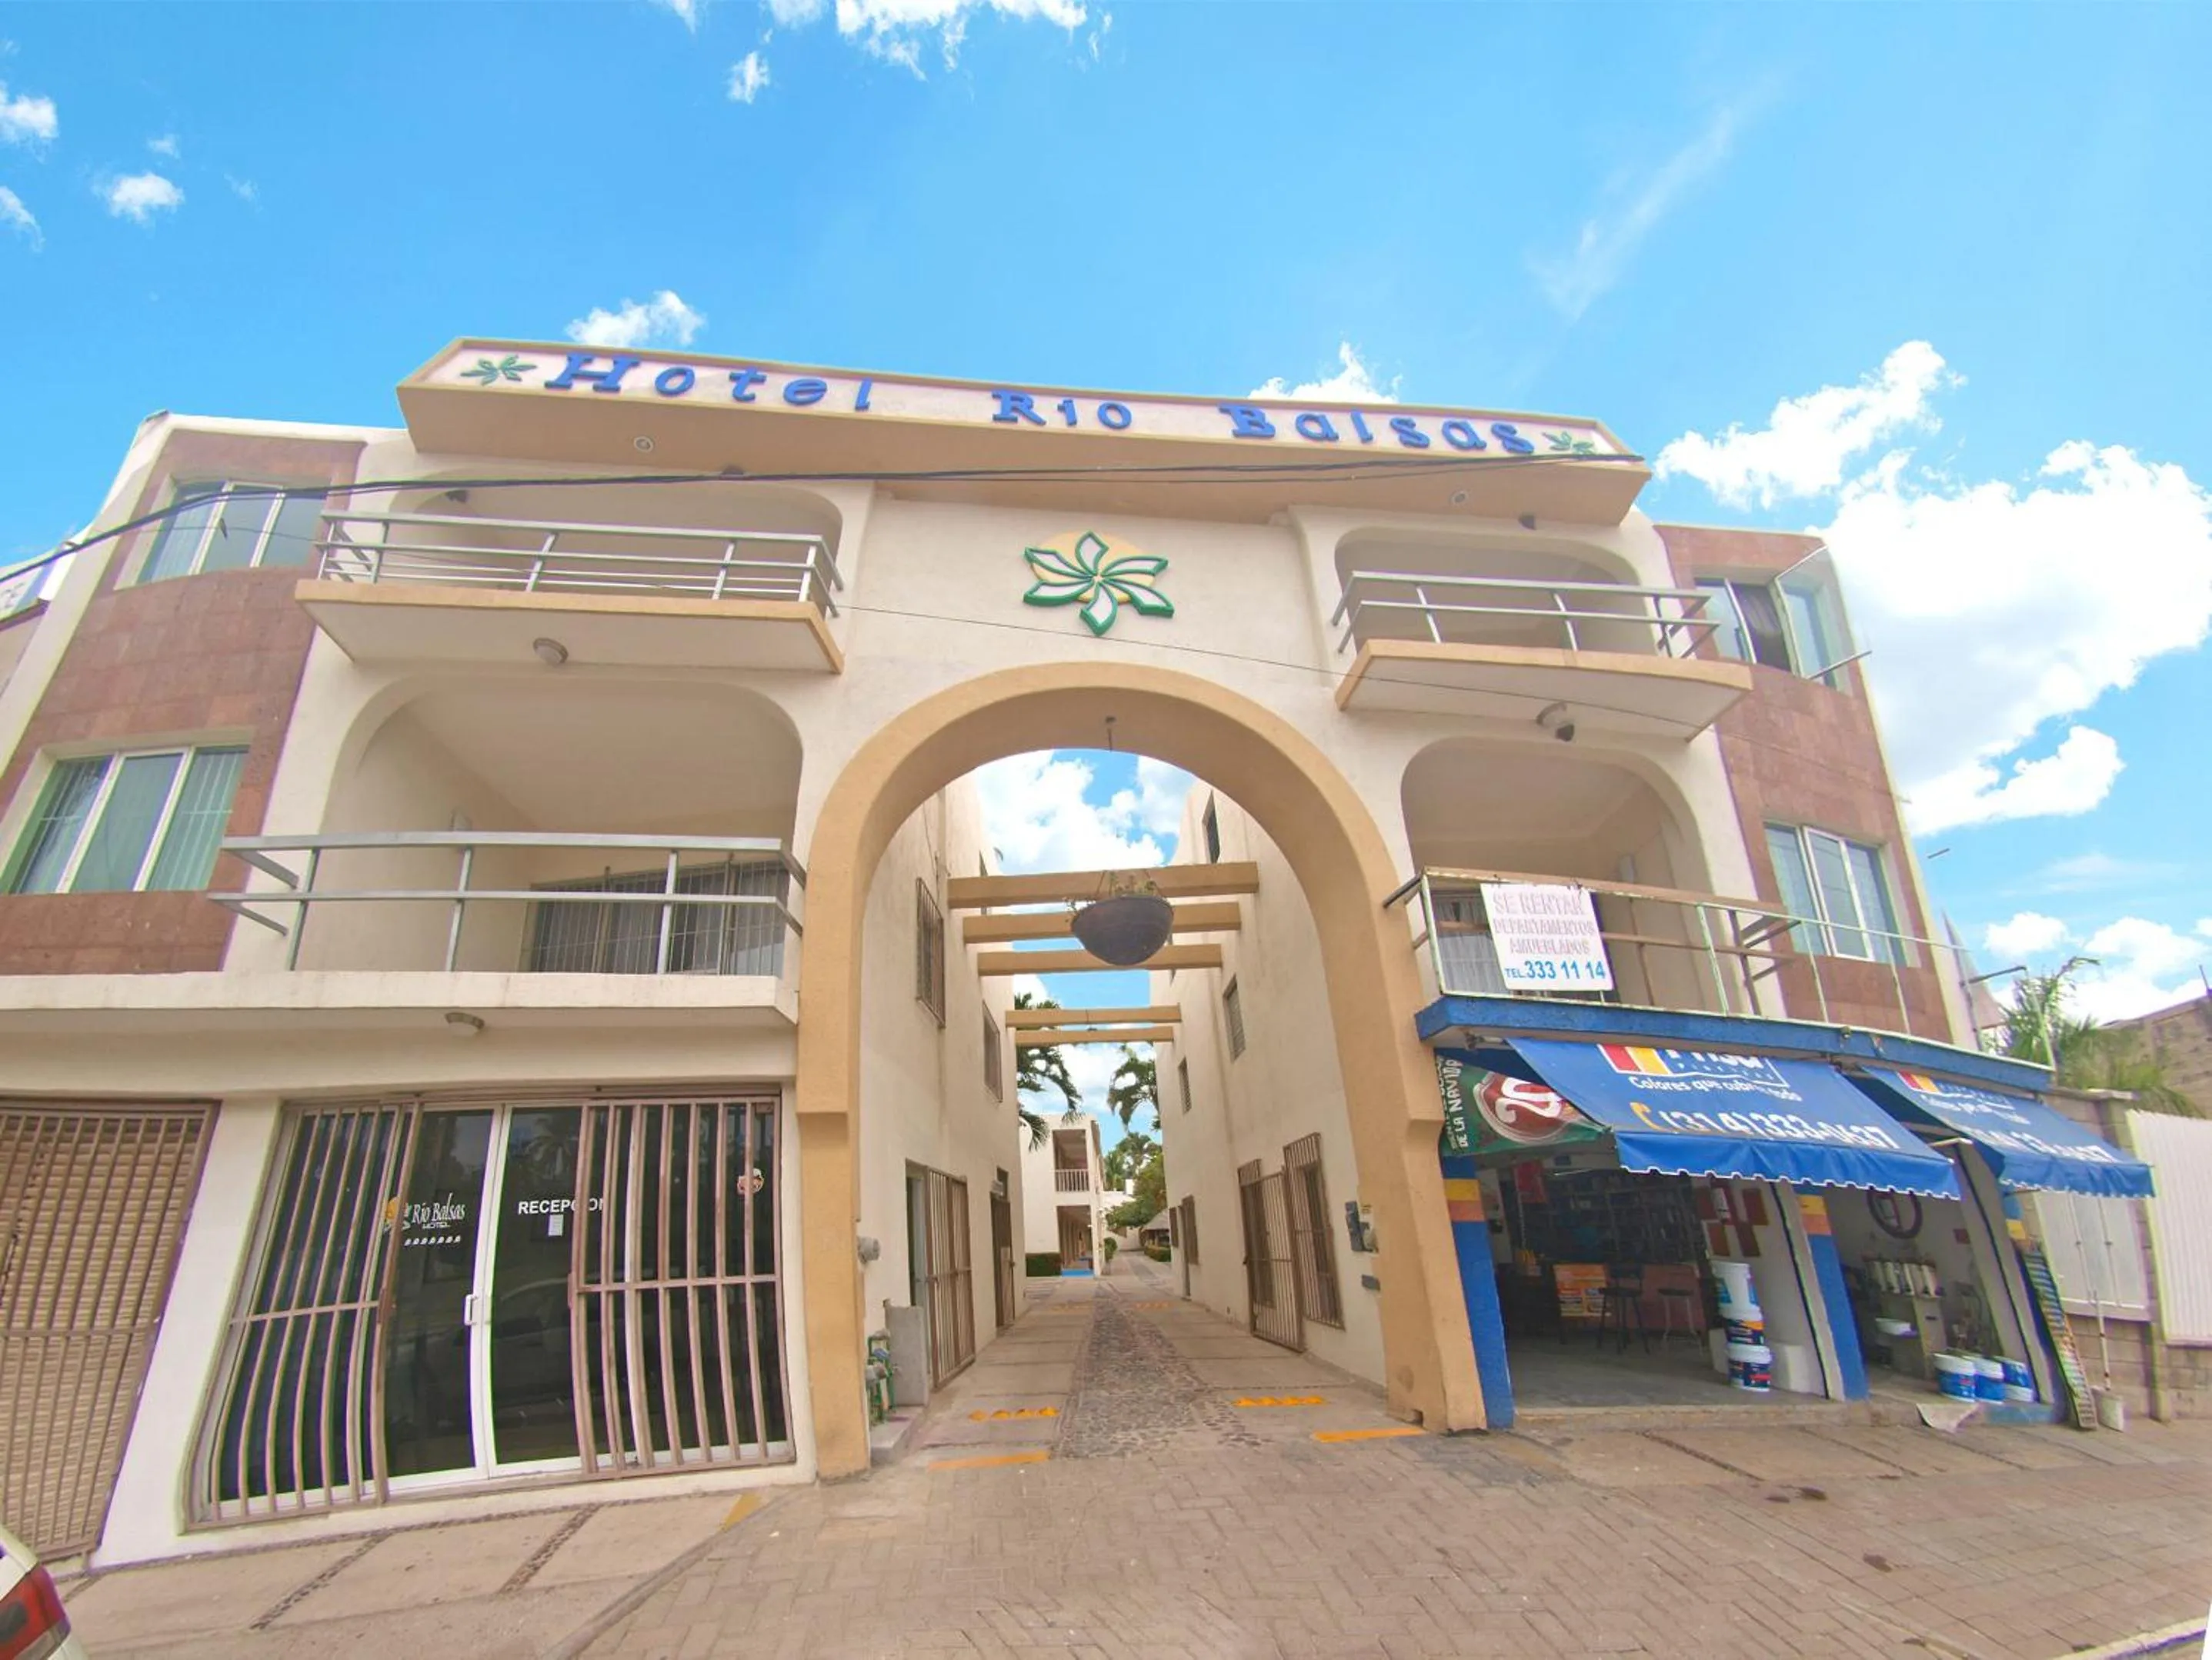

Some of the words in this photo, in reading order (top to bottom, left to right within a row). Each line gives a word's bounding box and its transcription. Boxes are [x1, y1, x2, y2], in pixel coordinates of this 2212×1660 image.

[544, 352, 872, 412] Hotel
[991, 389, 1132, 430] Rio
[1219, 403, 1534, 454] Balsas
[1525, 961, 1556, 979] 333
[1560, 961, 1580, 979] 11
[1586, 961, 1606, 979] 14
[1443, 1058, 1463, 1113] NAVIDA
[1628, 1076, 1691, 1092] Colores
[1453, 1117, 1466, 1132] LA
[432, 1192, 465, 1222] Balsas
[519, 1198, 604, 1215] RECEPO
